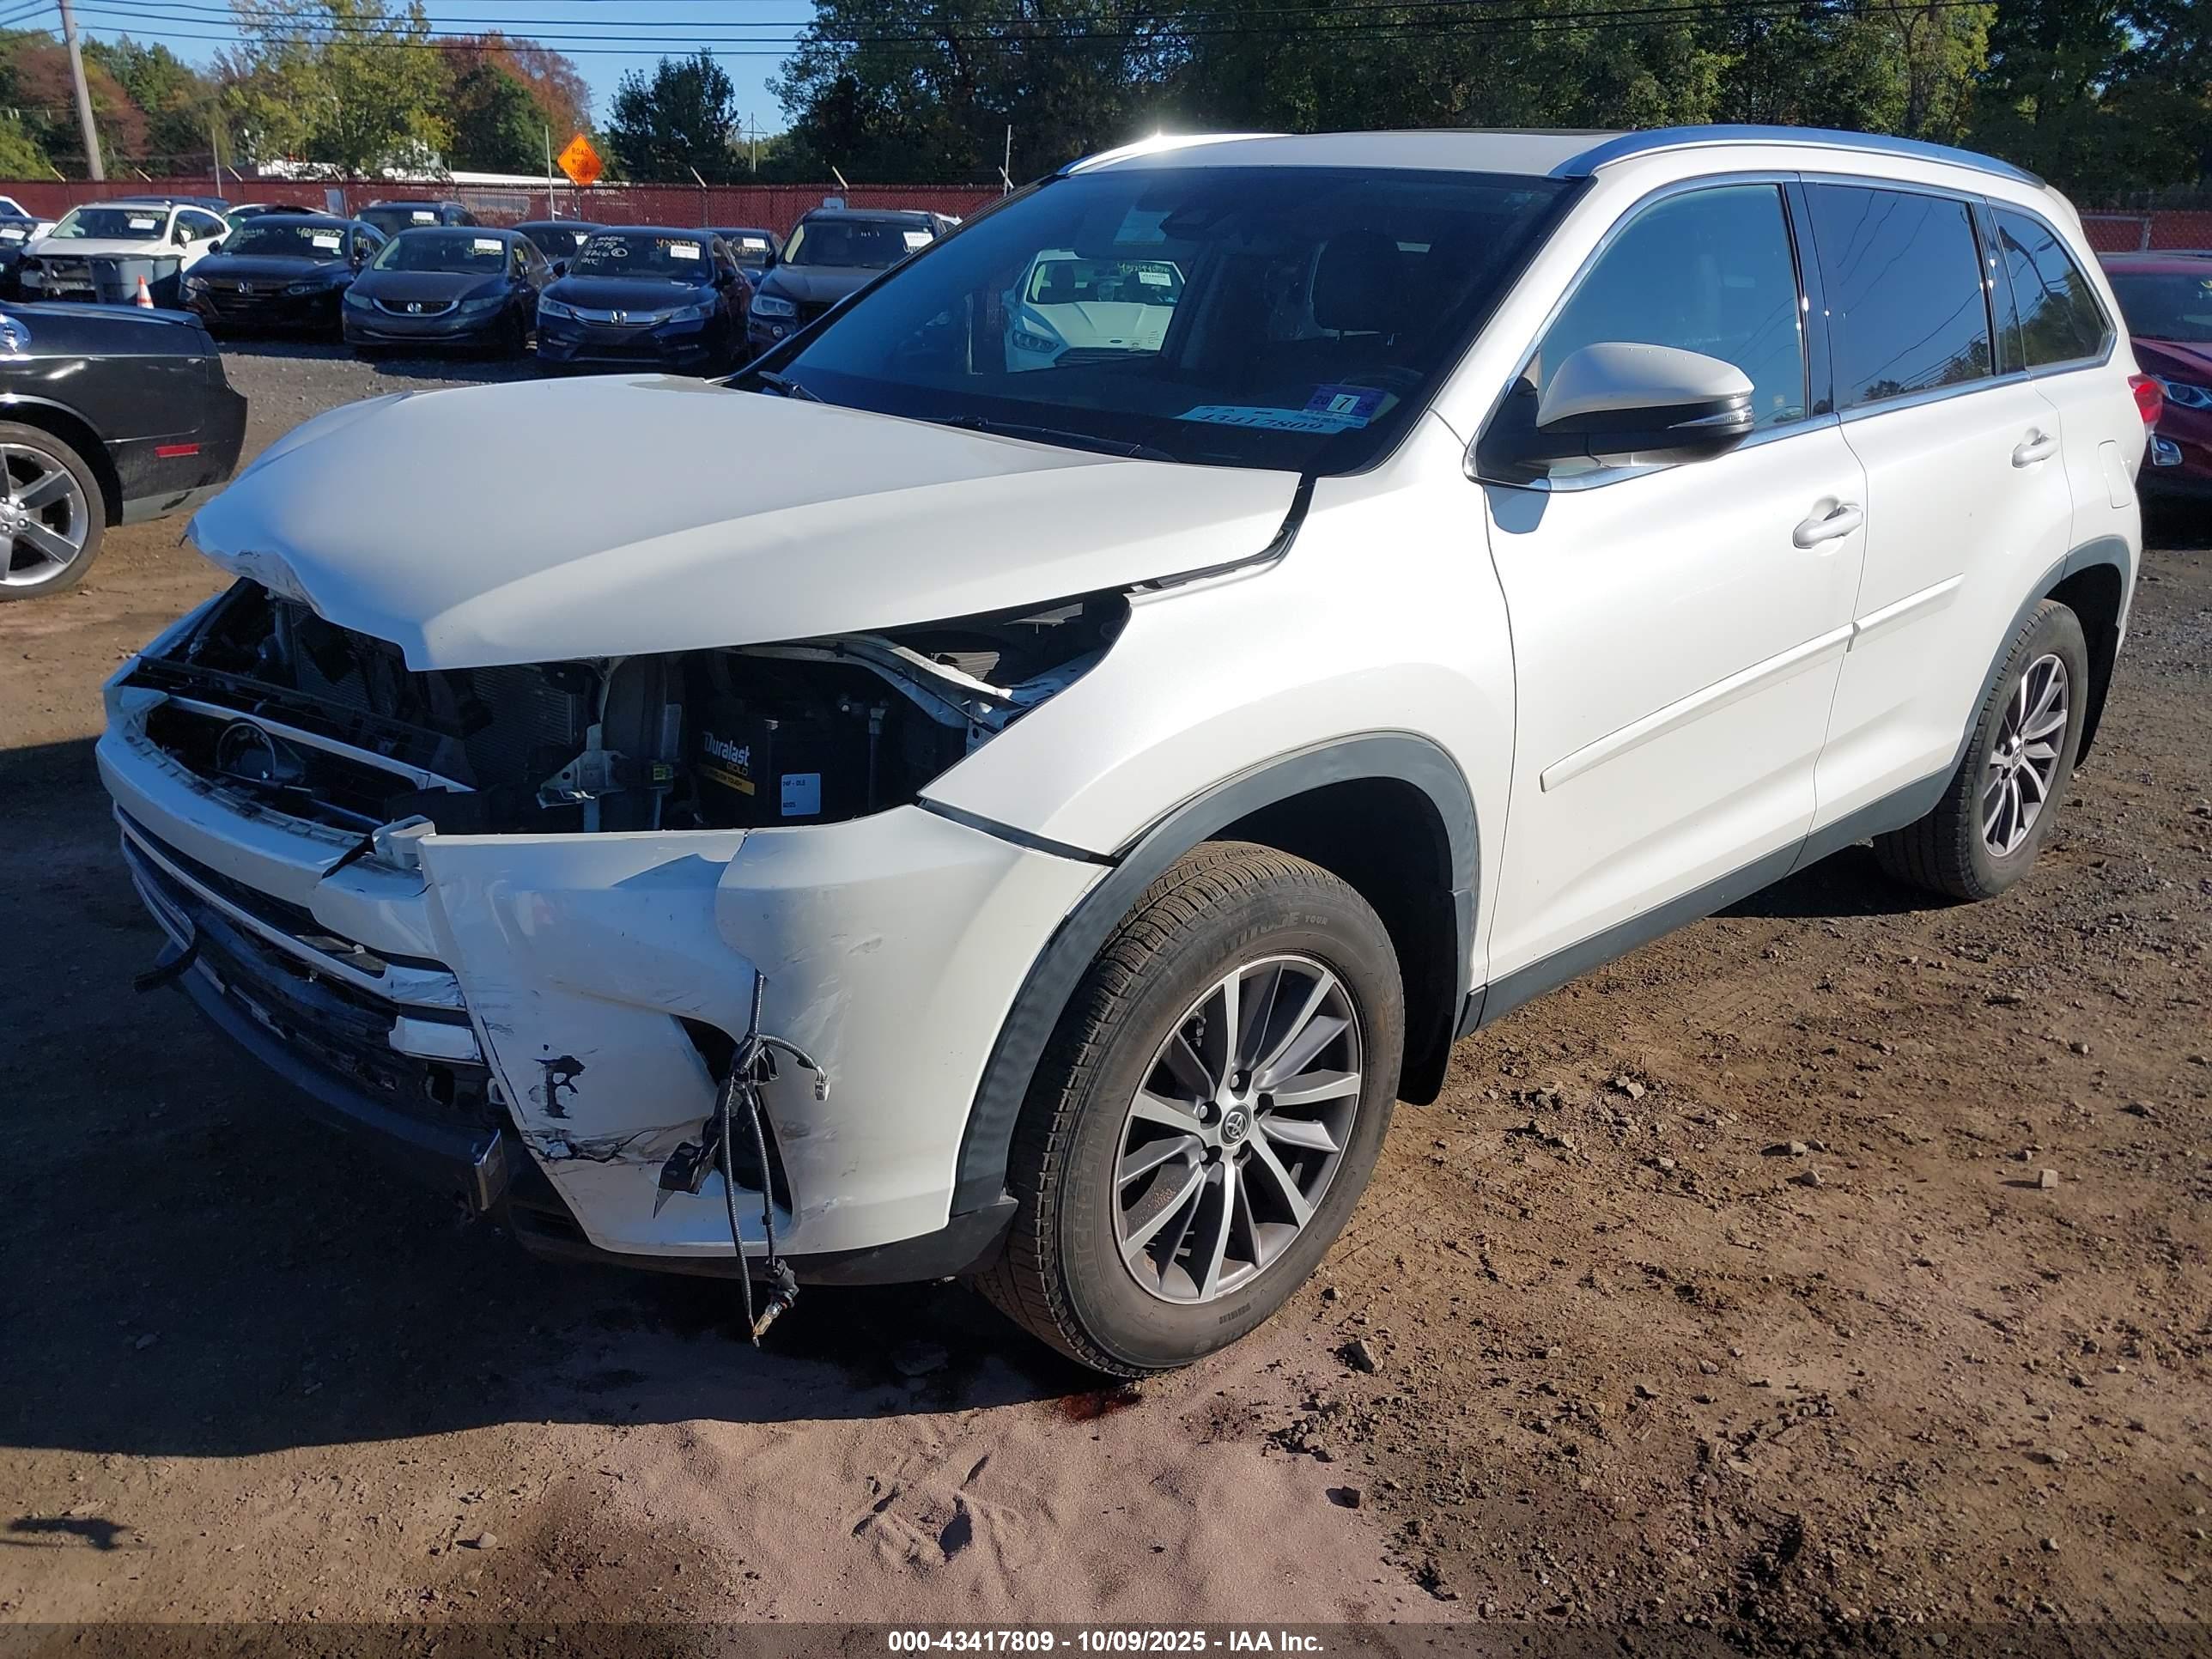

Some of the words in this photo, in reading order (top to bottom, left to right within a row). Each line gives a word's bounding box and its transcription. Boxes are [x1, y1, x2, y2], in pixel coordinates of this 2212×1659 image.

[571, 147, 589, 155] ROAD
[571, 158, 589, 167] WORK
[1337, 397, 1352, 410] 7
[702, 731, 750, 767] Duralast
